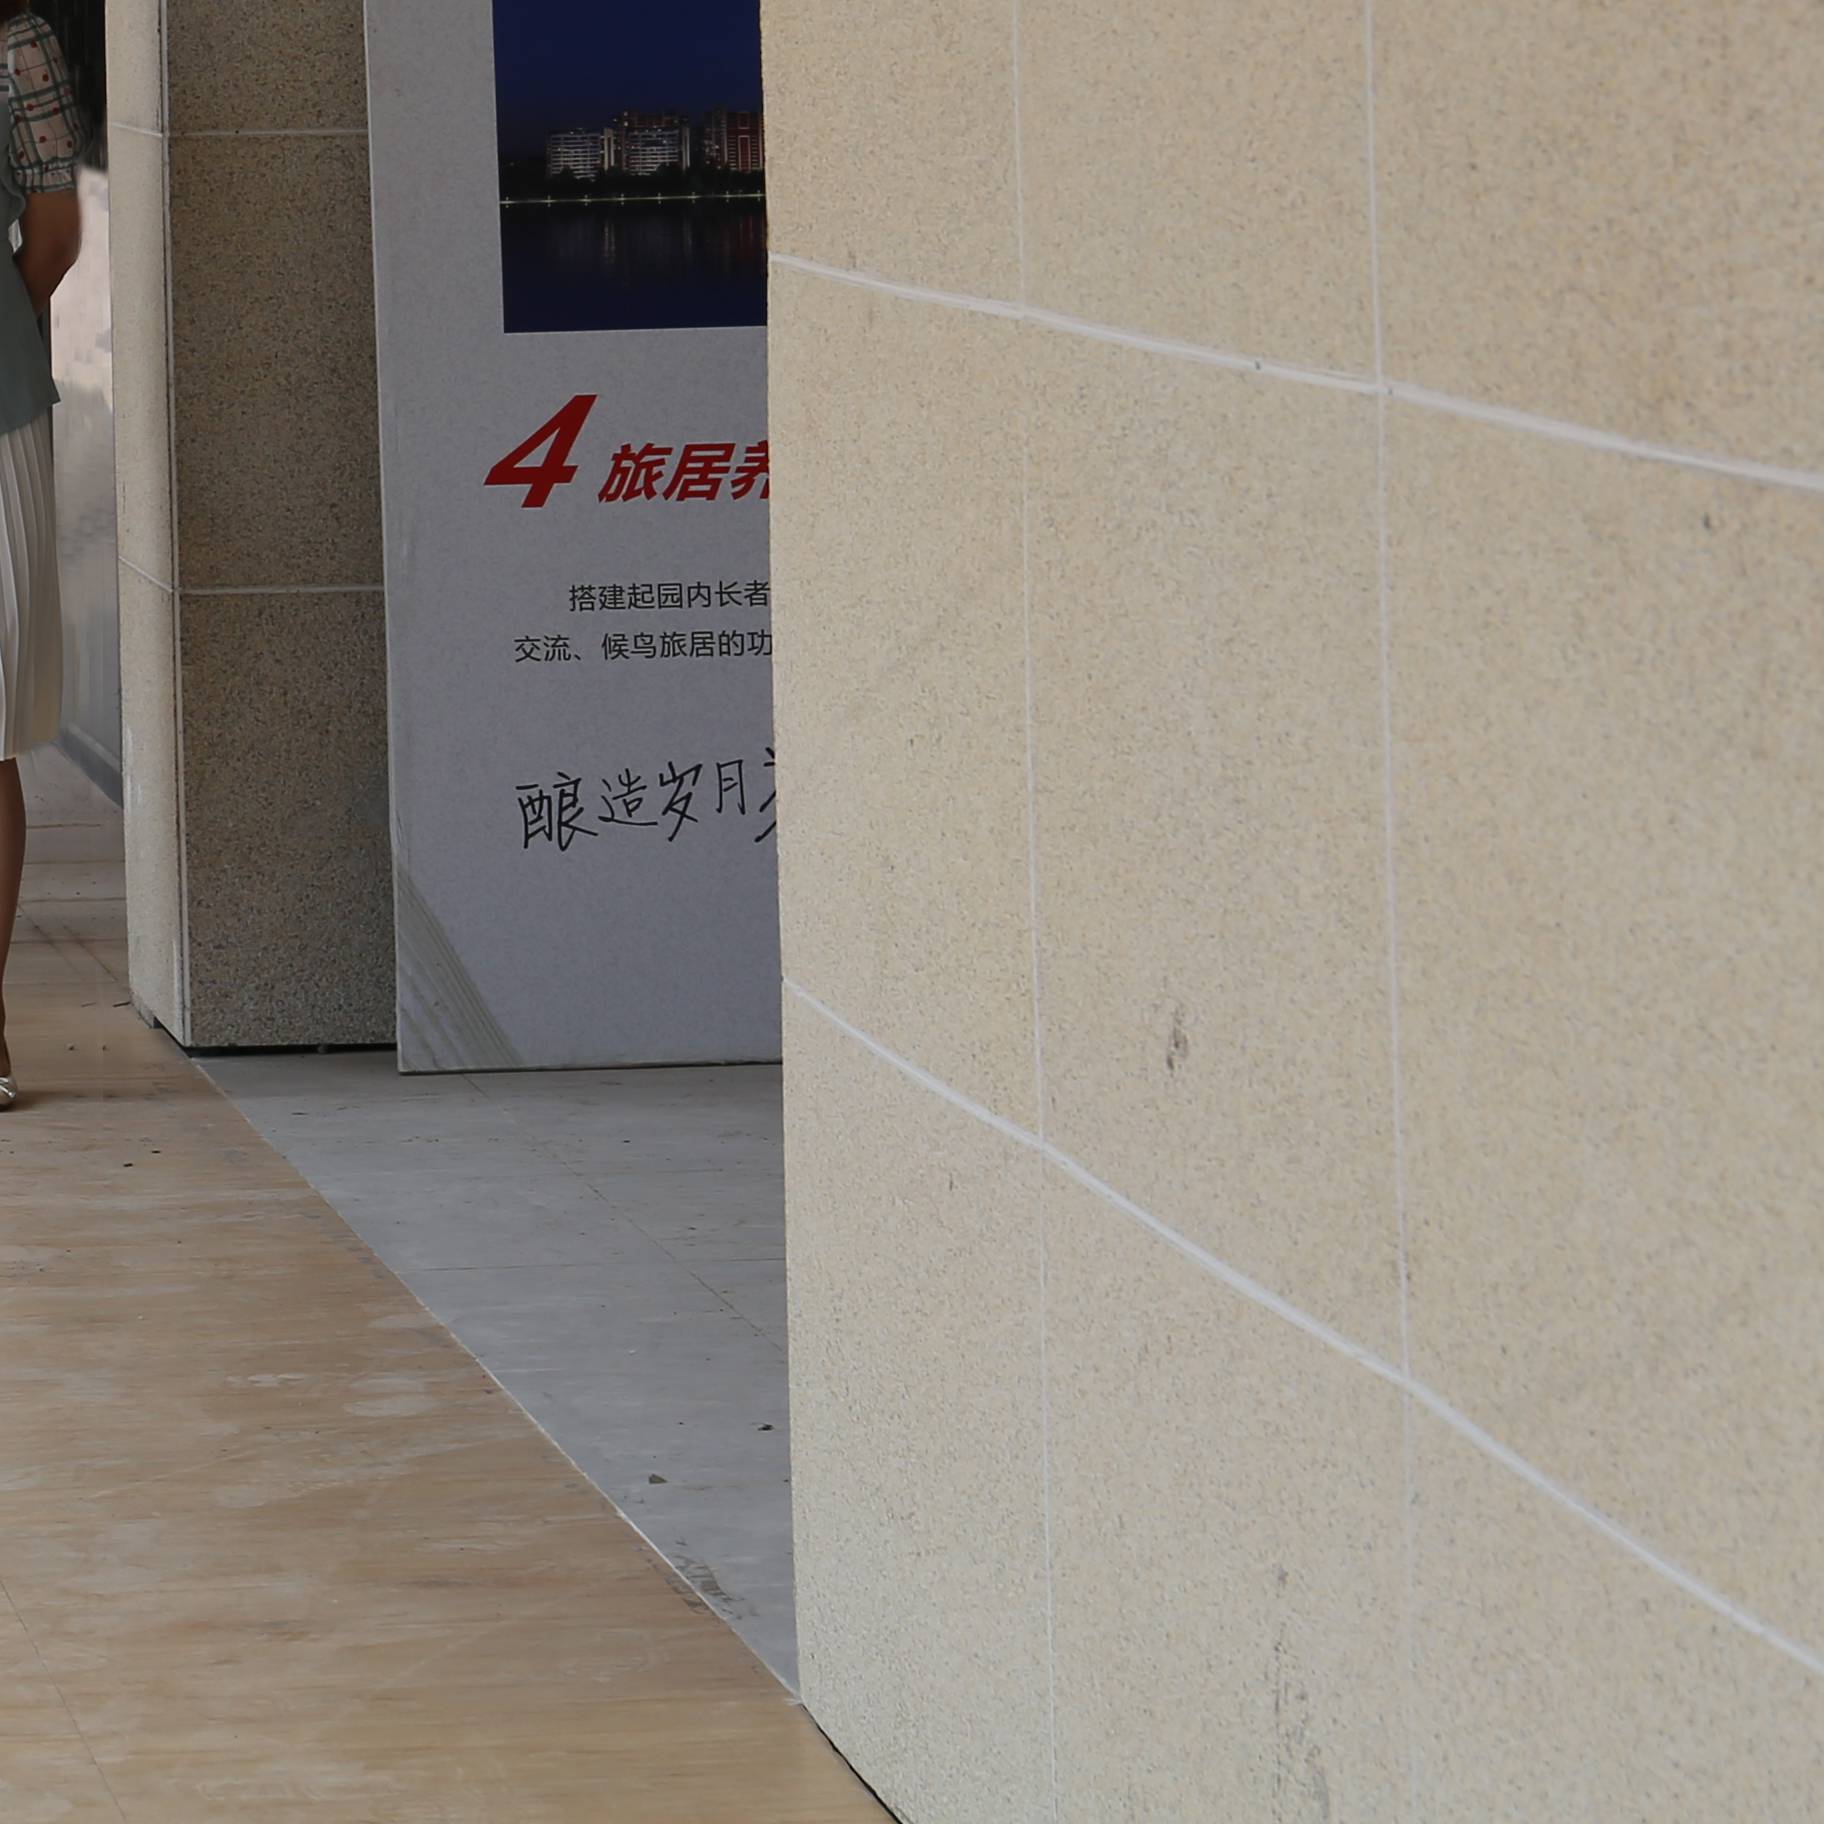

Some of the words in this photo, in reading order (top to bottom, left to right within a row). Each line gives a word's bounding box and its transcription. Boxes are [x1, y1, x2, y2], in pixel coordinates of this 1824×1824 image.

[483, 394, 598, 508] 4
[569, 580, 770, 612] 搭建起园内长者
[514, 629, 773, 663] 交流、候鸟旅居的功
